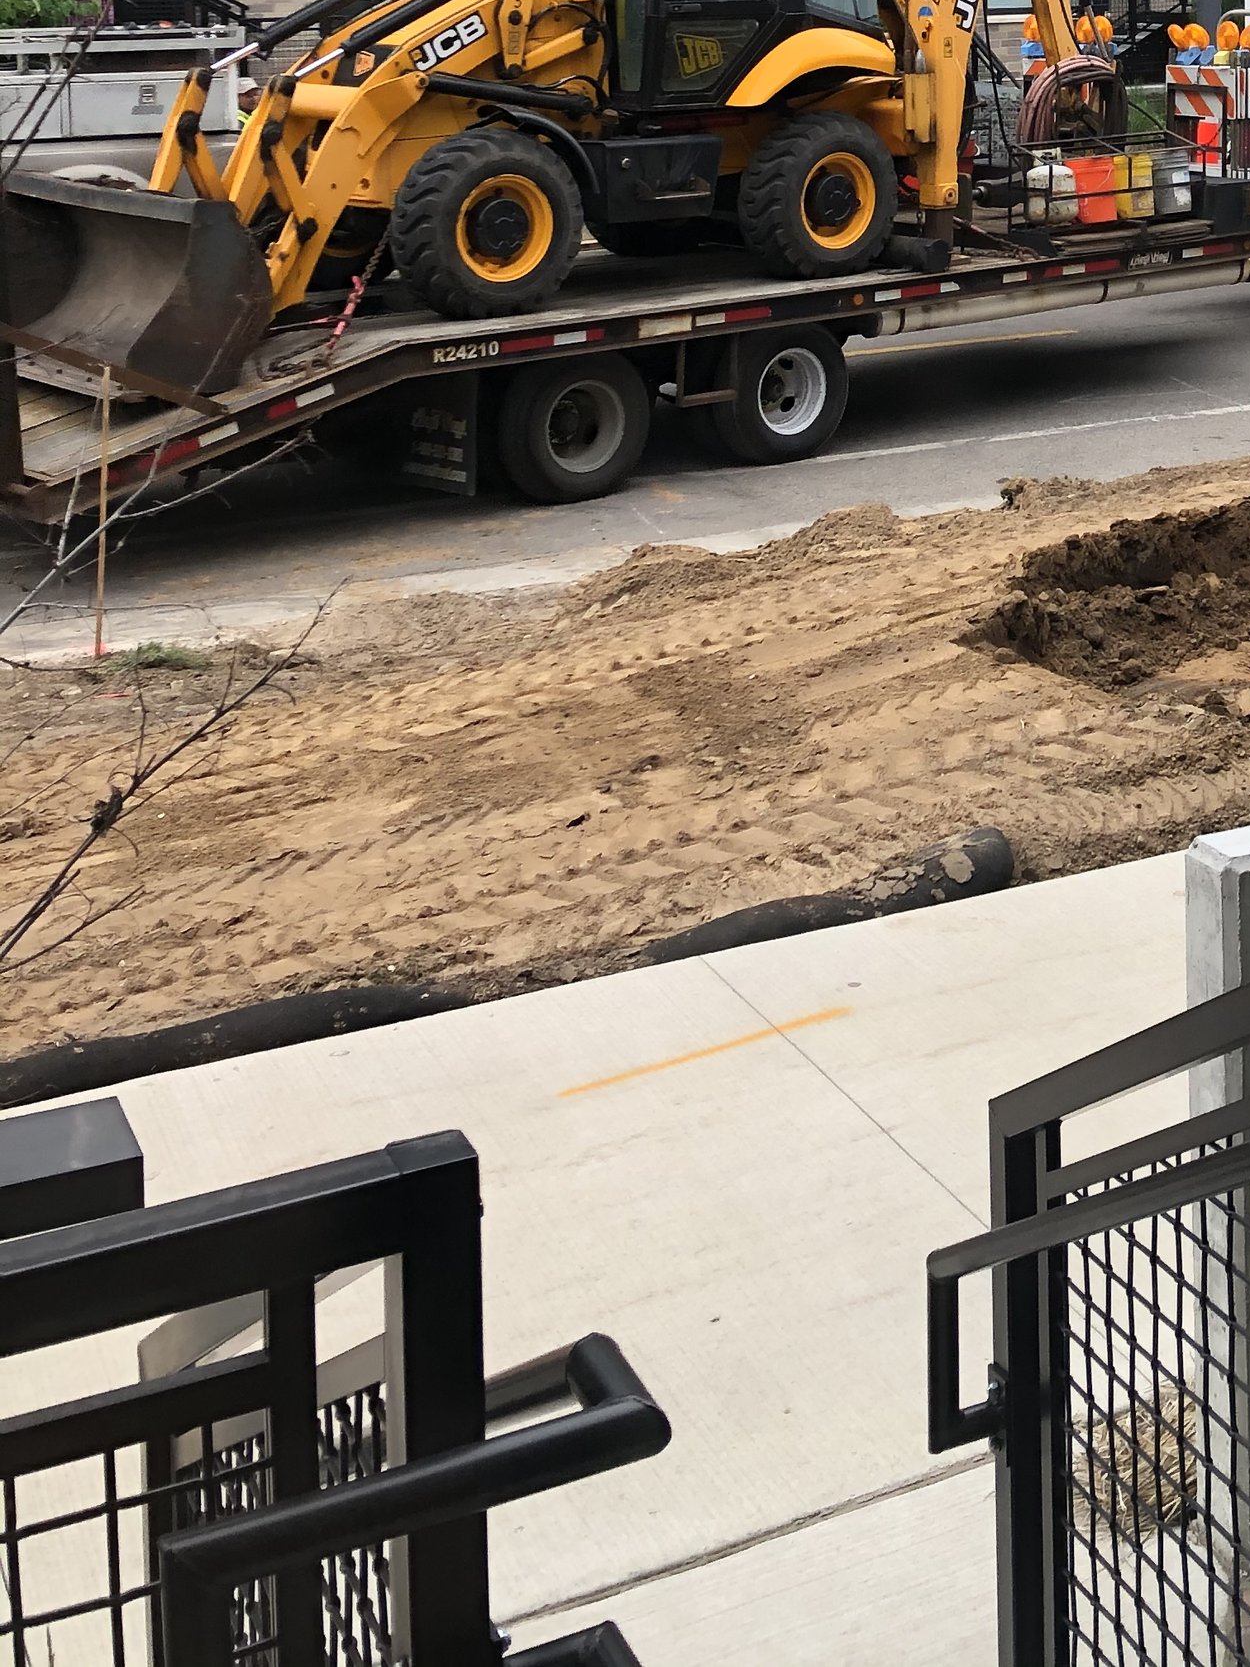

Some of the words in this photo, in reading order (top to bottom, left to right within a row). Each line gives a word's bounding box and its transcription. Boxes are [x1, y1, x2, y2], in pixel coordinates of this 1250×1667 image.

[415, 14, 486, 71] JCB
[681, 37, 720, 74] JCB
[433, 340, 500, 363] R24210
